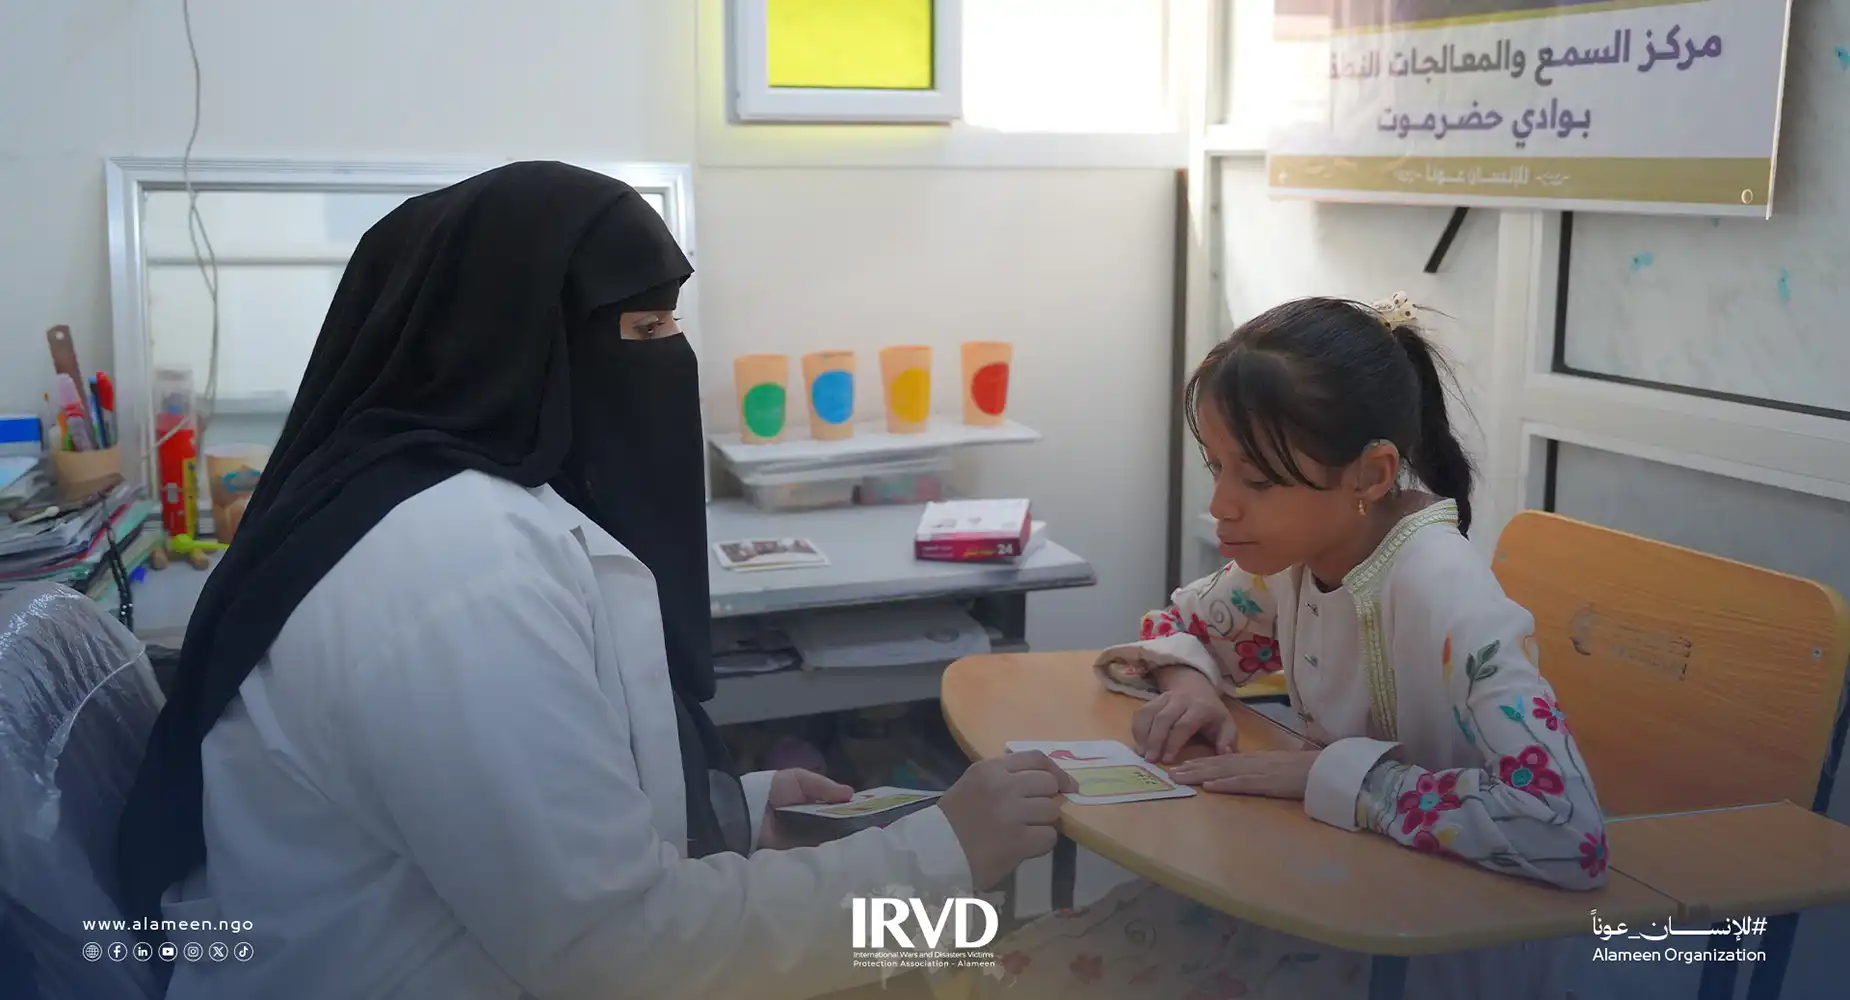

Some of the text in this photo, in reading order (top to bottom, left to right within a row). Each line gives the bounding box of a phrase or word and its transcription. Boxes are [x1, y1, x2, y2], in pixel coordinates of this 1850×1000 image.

[1388, 39, 1525, 84] والمعالجات
[1534, 28, 1631, 86] السمع
[1637, 24, 1722, 72] مركز
[1377, 97, 1591, 149] بوادي حضرموت
[996, 543, 1013, 555] 24
